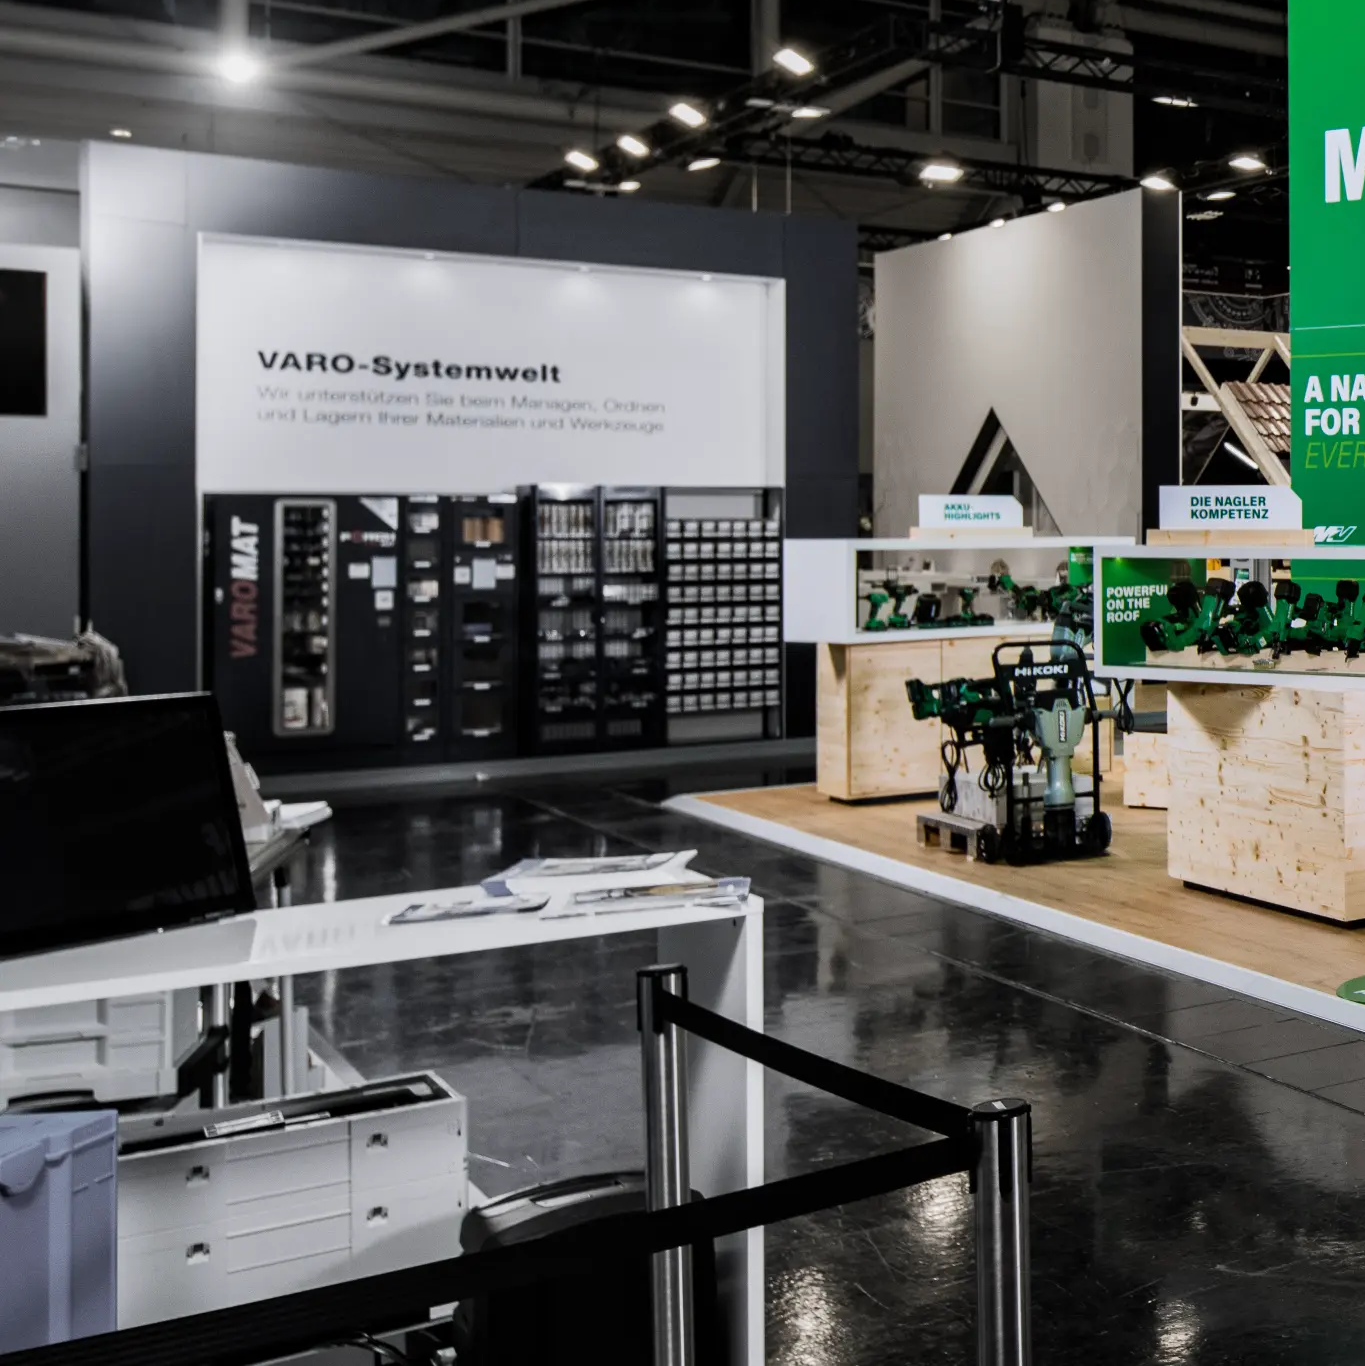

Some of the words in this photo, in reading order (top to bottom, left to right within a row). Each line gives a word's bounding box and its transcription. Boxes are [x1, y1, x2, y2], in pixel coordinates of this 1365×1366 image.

[258, 351, 561, 383] VARO-Systemwelt
[257, 386, 289, 401] Wir
[1304, 375, 1323, 403] A
[1304, 407, 1360, 436] FOR
[1190, 496, 1210, 508] DIE
[1214, 495, 1266, 508] NAGLER
[1190, 507, 1269, 520] KOMPETENZ
[231, 515, 258, 659] VAROMAT
[1106, 599, 1124, 610] ON
[1127, 597, 1151, 609] THE
[1106, 610, 1140, 623] ROOF
[1014, 664, 1069, 677] HiKOKI
